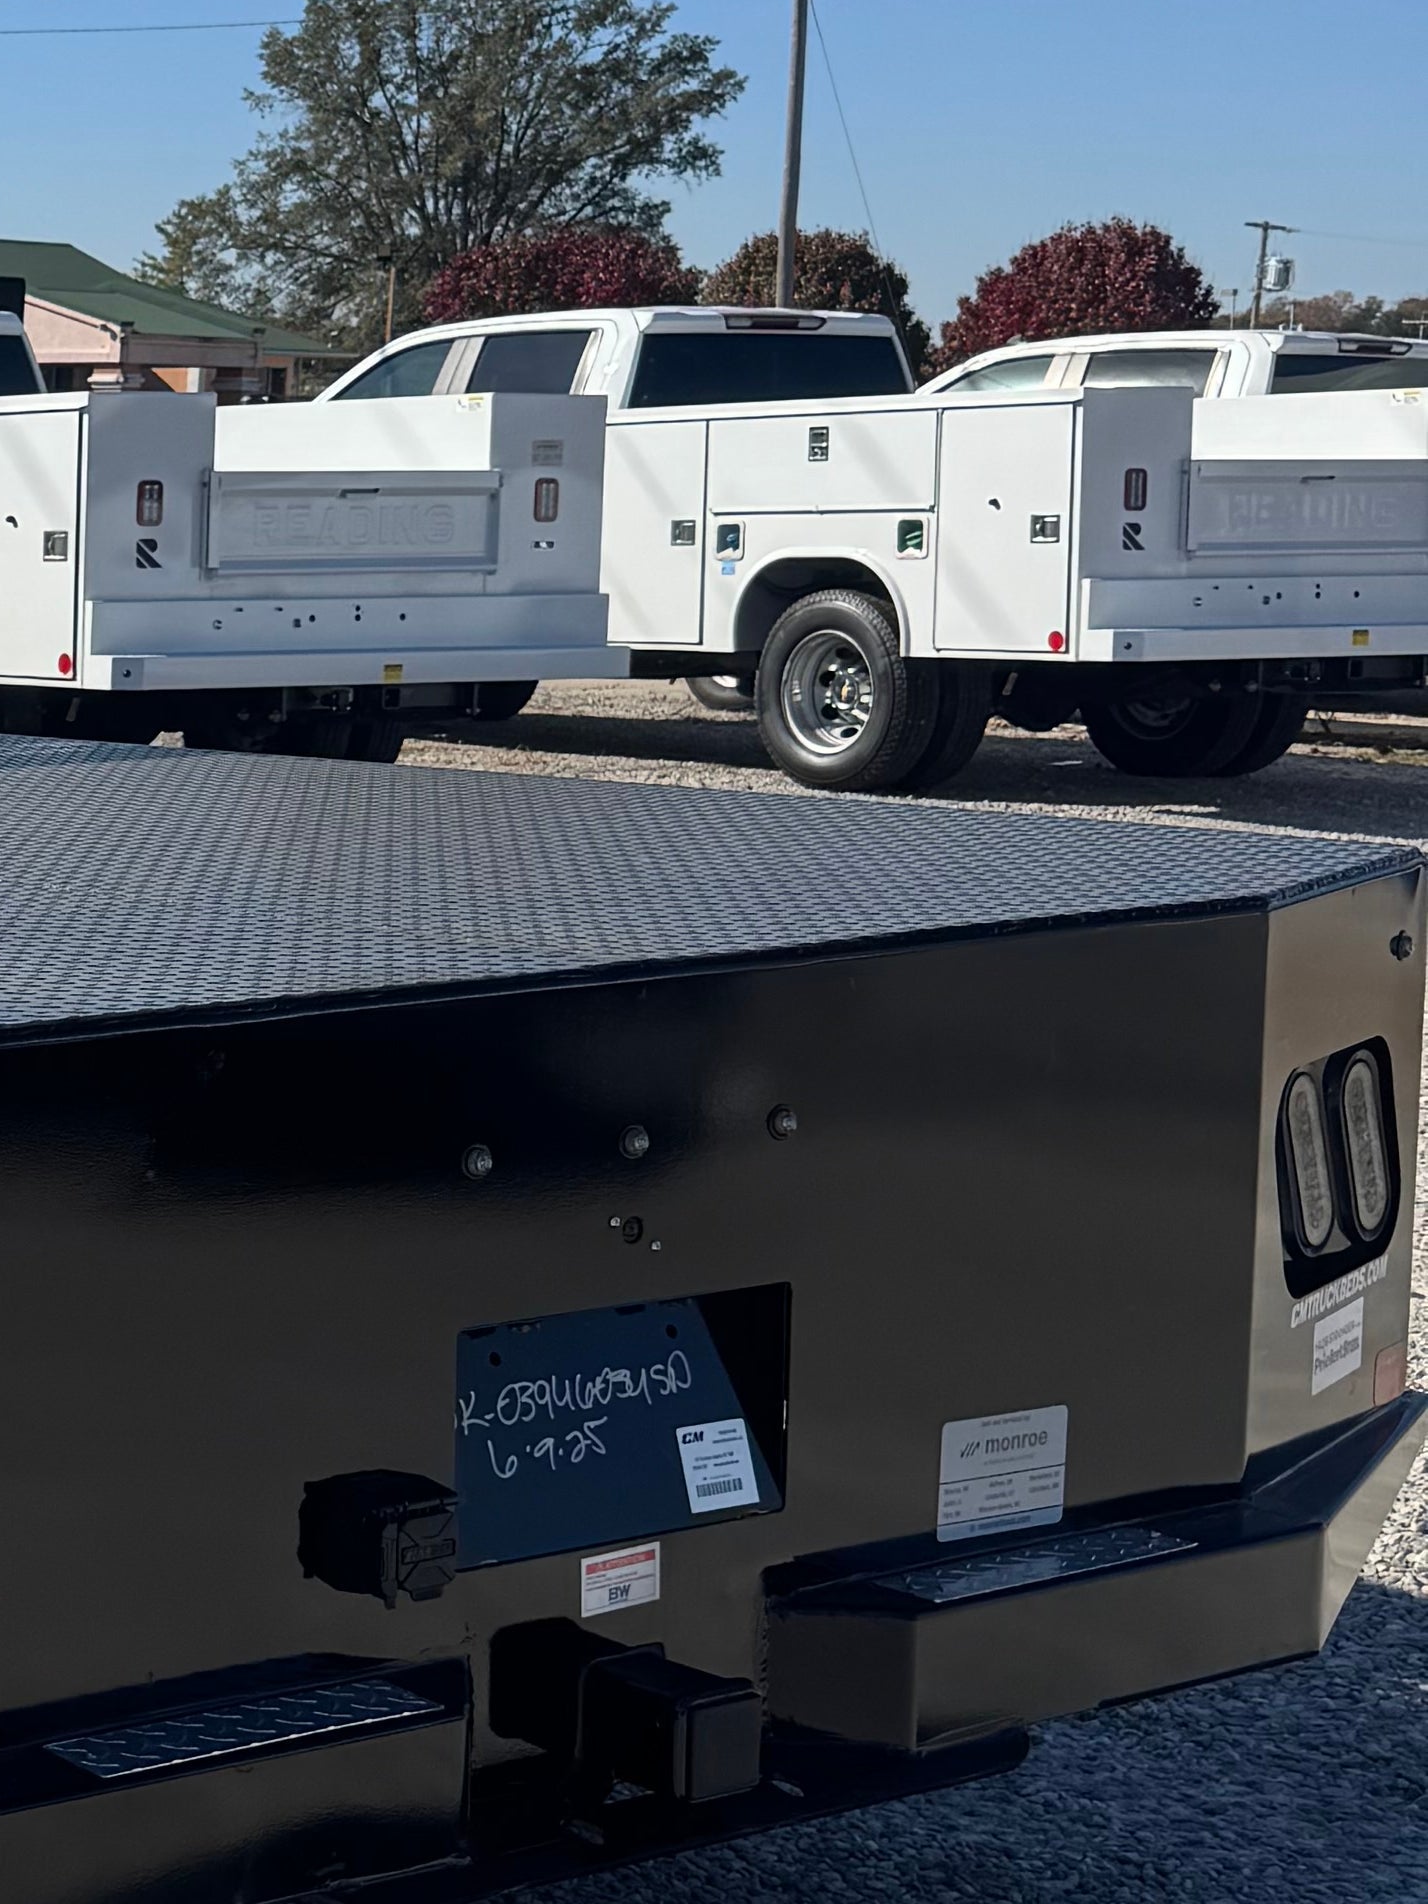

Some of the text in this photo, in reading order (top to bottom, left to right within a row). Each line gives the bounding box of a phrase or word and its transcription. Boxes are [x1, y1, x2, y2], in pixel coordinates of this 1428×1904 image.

[252, 503, 456, 547] READING
[1291, 1254, 1389, 1329] CMTRUCKBEDS.COM
[985, 1430, 1048, 1454] monroe
